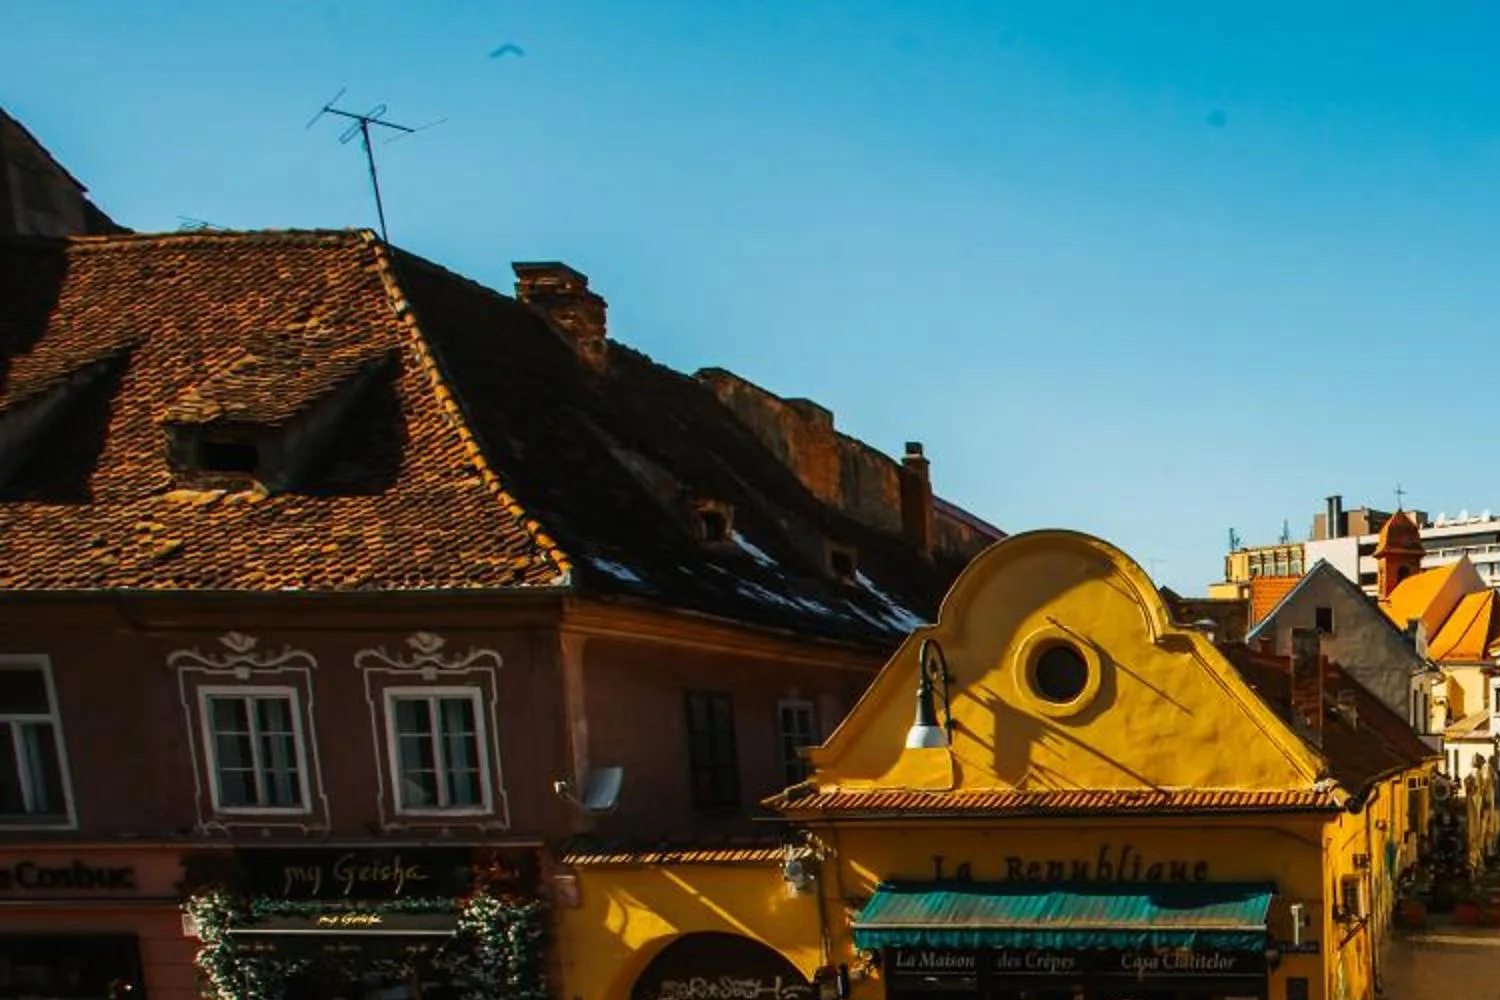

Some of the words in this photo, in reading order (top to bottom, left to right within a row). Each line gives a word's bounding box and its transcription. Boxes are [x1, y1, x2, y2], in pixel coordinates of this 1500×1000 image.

[283, 861, 322, 896] my
[895, 950, 916, 969] La
[918, 950, 977, 969] Maison
[1120, 951, 1161, 970] Casa
